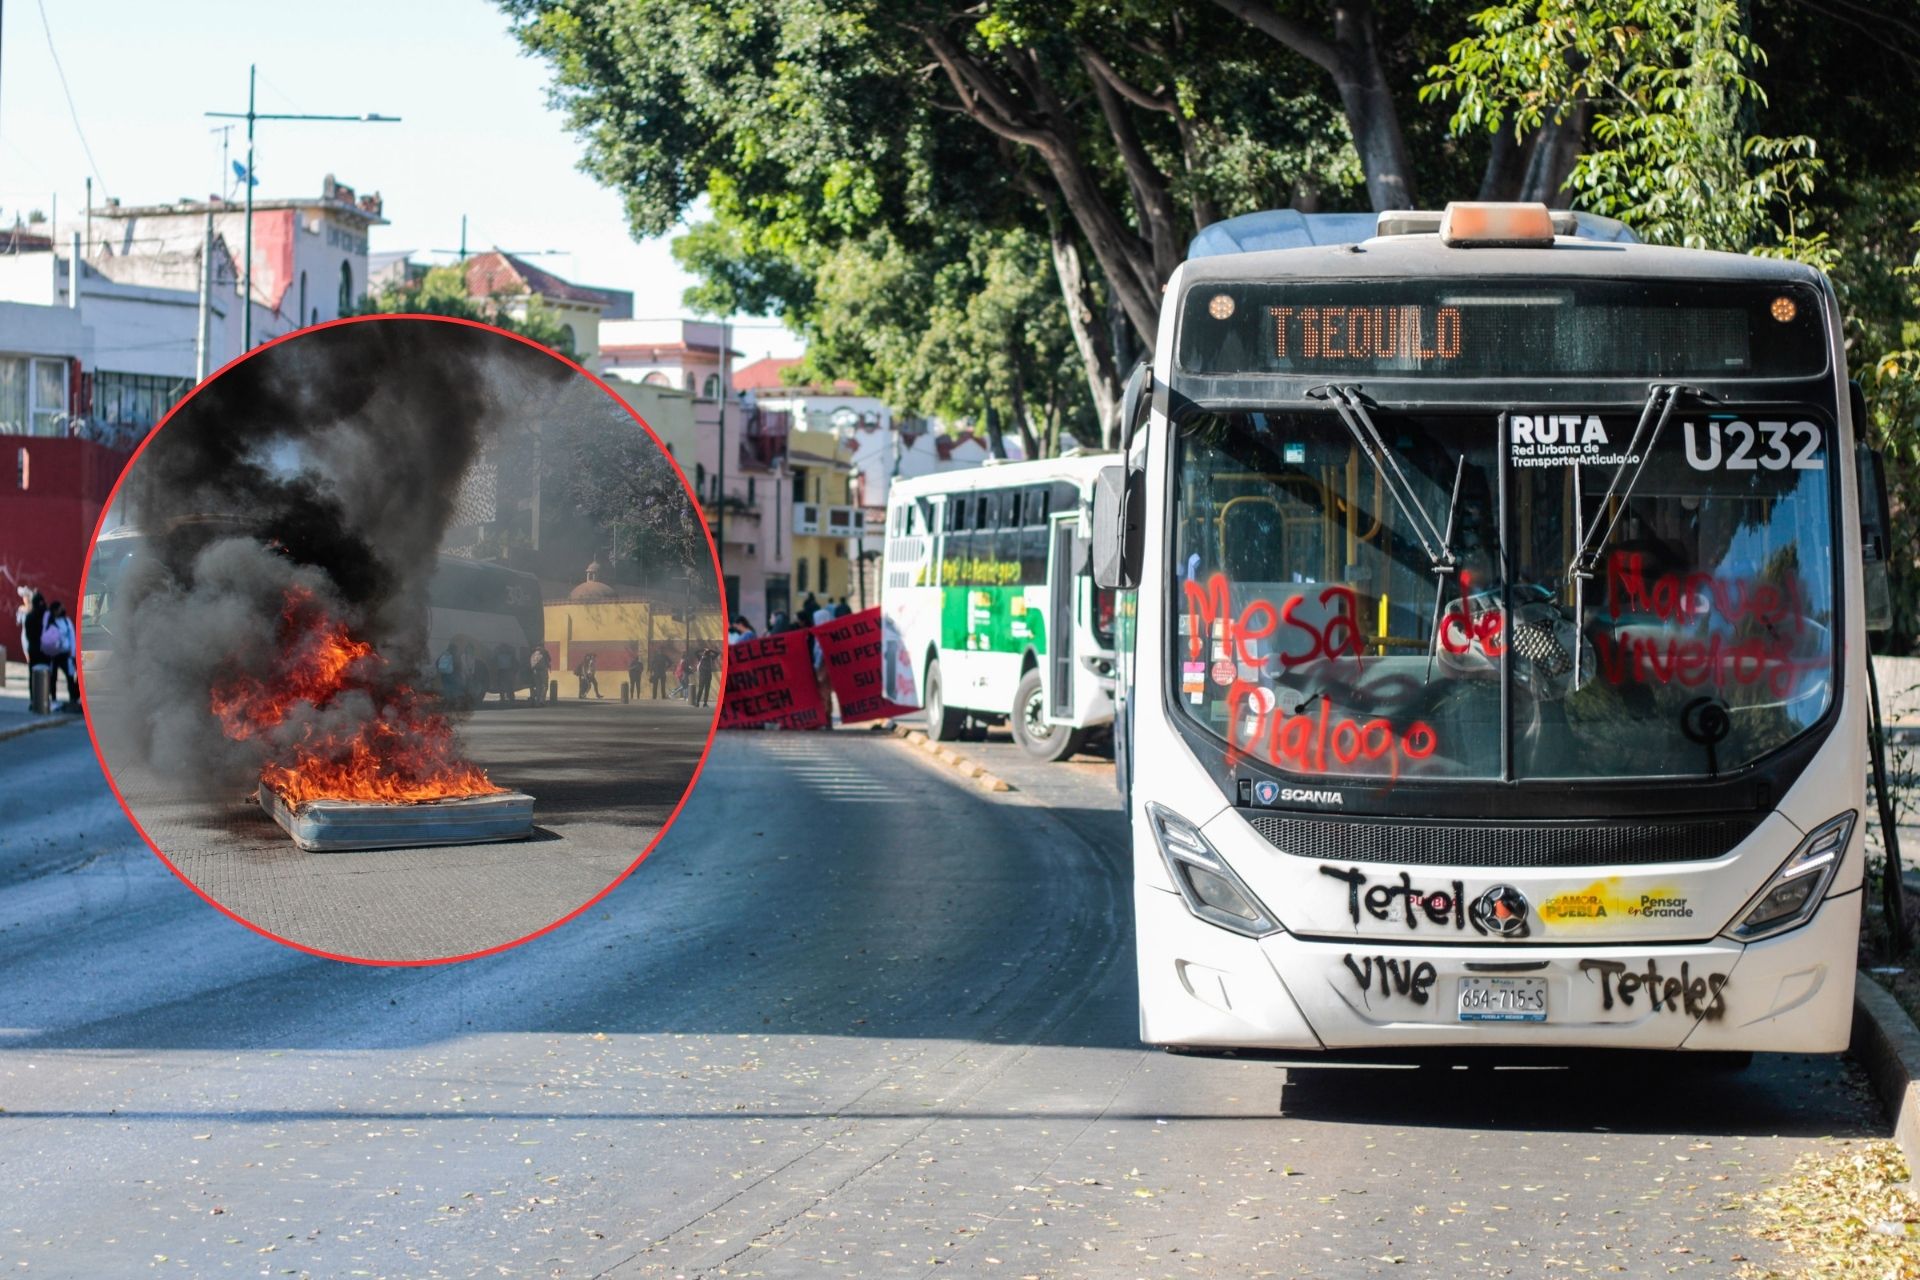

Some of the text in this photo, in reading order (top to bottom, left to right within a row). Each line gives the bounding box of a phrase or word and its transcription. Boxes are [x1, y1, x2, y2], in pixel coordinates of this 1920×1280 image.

[1510, 415, 1609, 444] RUTA
[1511, 443, 1599, 455] Red Urbana de
[1683, 421, 1824, 471] U232
[1512, 456, 1577, 468] Transporte
[1184, 569, 1508, 672] Mesa de
[1281, 788, 1344, 804] SCANIA
[1640, 895, 1687, 908] Pensar
[1642, 906, 1693, 918] Grande
[1462, 989, 1544, 1009] 654-715-S
[1579, 958, 1730, 1022] Teteles
